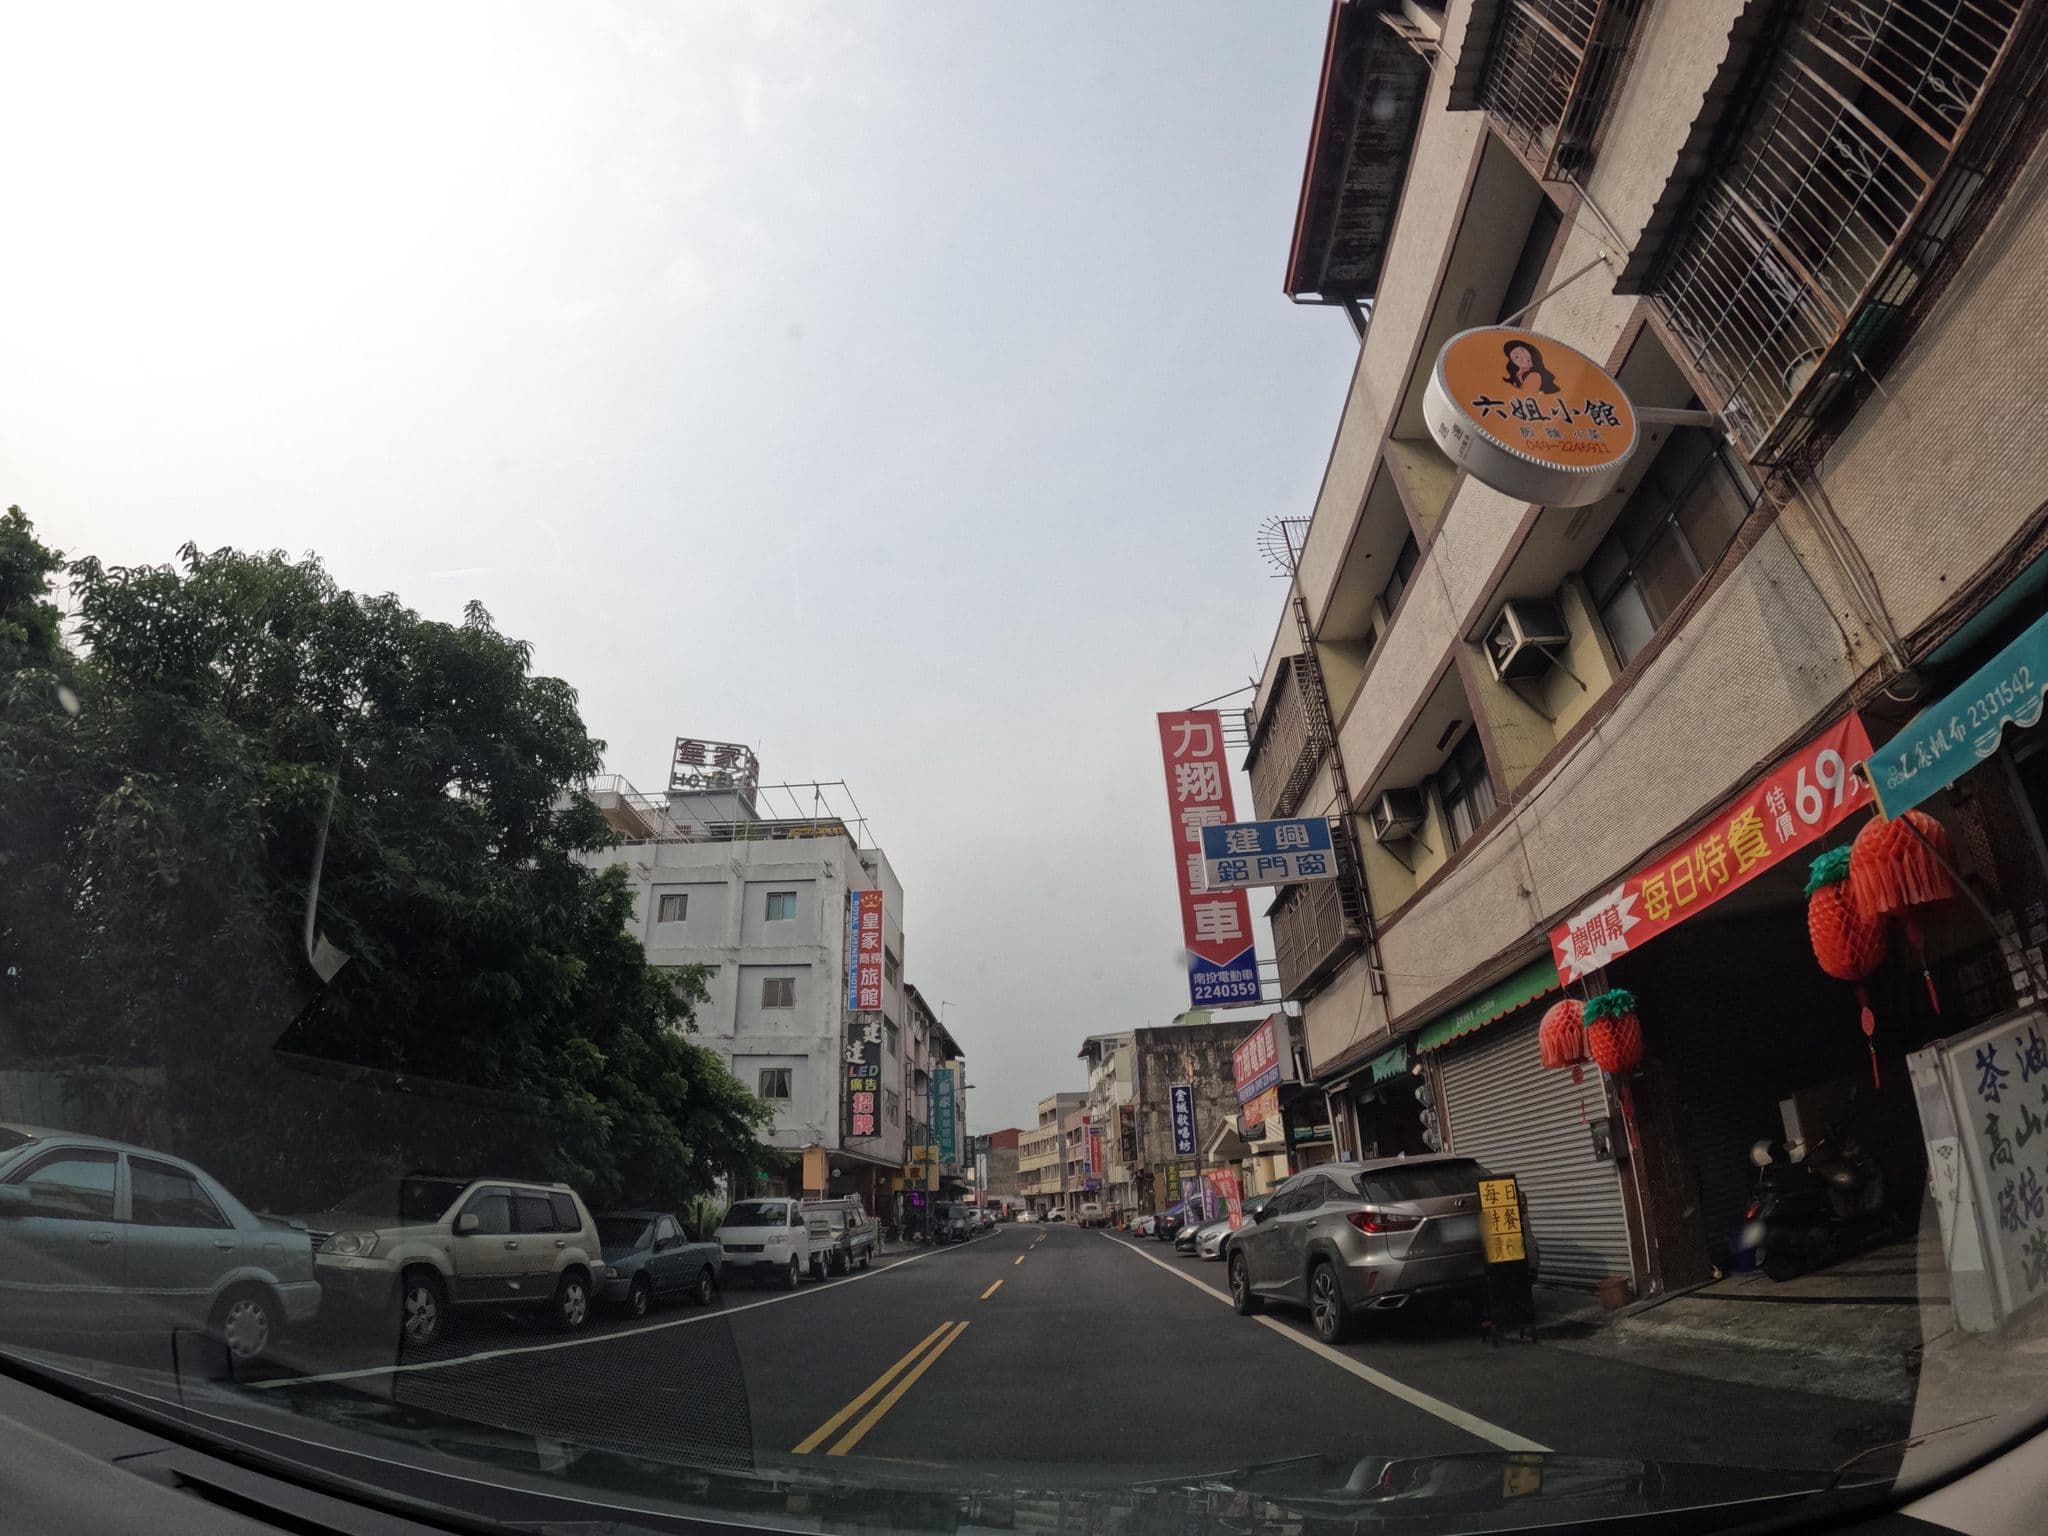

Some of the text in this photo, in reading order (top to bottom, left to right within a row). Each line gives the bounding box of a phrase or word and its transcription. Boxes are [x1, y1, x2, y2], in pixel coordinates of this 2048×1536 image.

[1967, 666, 2034, 729] 2331542
[1170, 720, 1242, 944] 力翔電車
[1766, 786, 1797, 844] 特價
[1224, 824, 1311, 854] 建興
[1217, 853, 1326, 883] 鋁門窗
[1641, 806, 1772, 923] 每日特餐
[1571, 904, 1624, 961] 慶開幕
[1193, 969, 1254, 986] 南投電動車
[1194, 981, 1256, 1000] 2240359
[849, 1065, 879, 1078] LED
[850, 1079, 878, 1091] 廣告
[852, 1092, 875, 1136] 招牌
[1985, 1083, 2048, 1171] 高山
[1482, 1183, 1516, 1204] 每日
